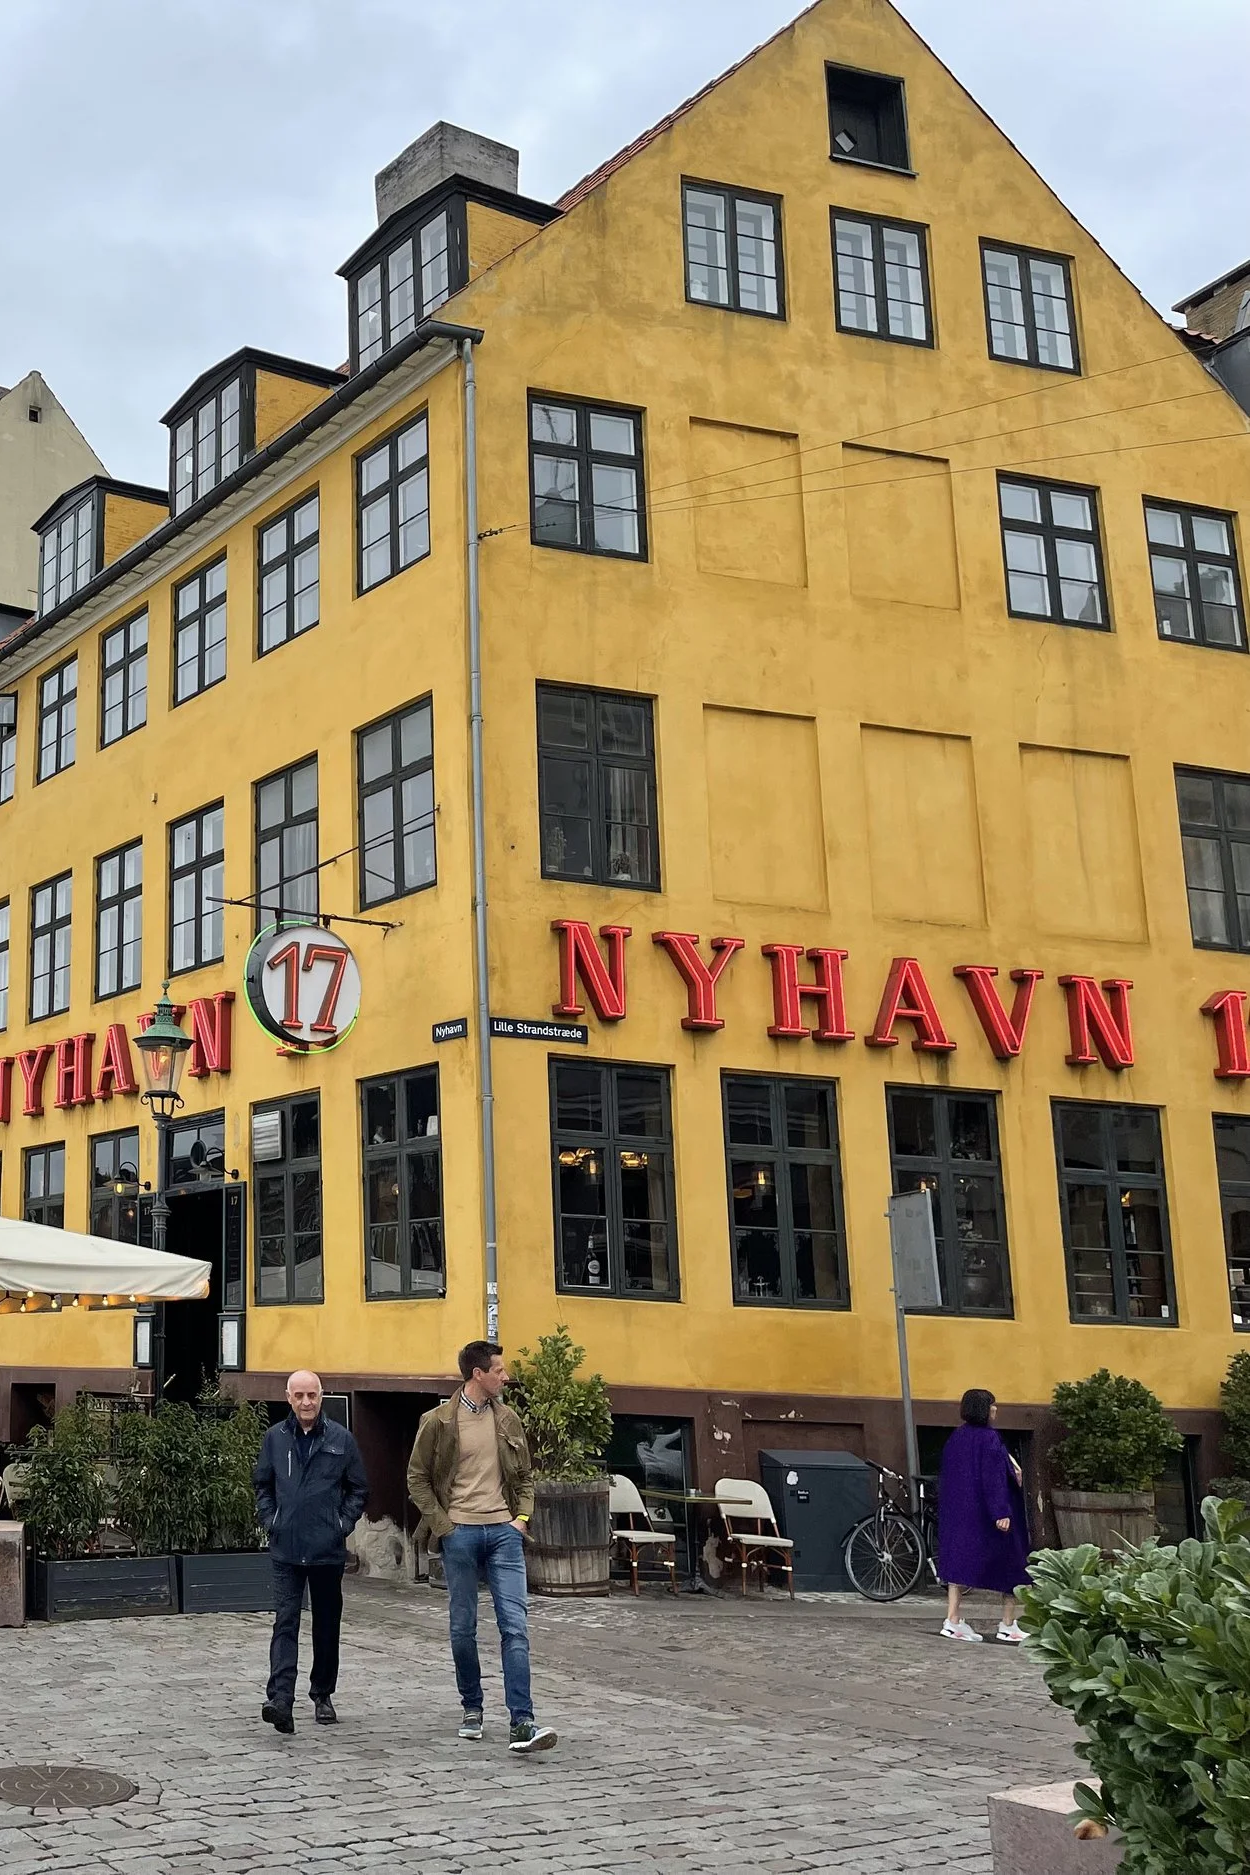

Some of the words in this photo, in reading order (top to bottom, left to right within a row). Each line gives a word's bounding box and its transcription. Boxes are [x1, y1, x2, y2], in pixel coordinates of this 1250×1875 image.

[267, 941, 351, 1033] 17
[551, 919, 1134, 1071] NYHAVN
[1199, 990, 1250, 1078] 1
[435, 1023, 463, 1039] Nyhavn
[493, 1020, 514, 1033] Lille
[516, 1023, 583, 1039] Strandstræde
[230, 1196, 239, 1206] 17
